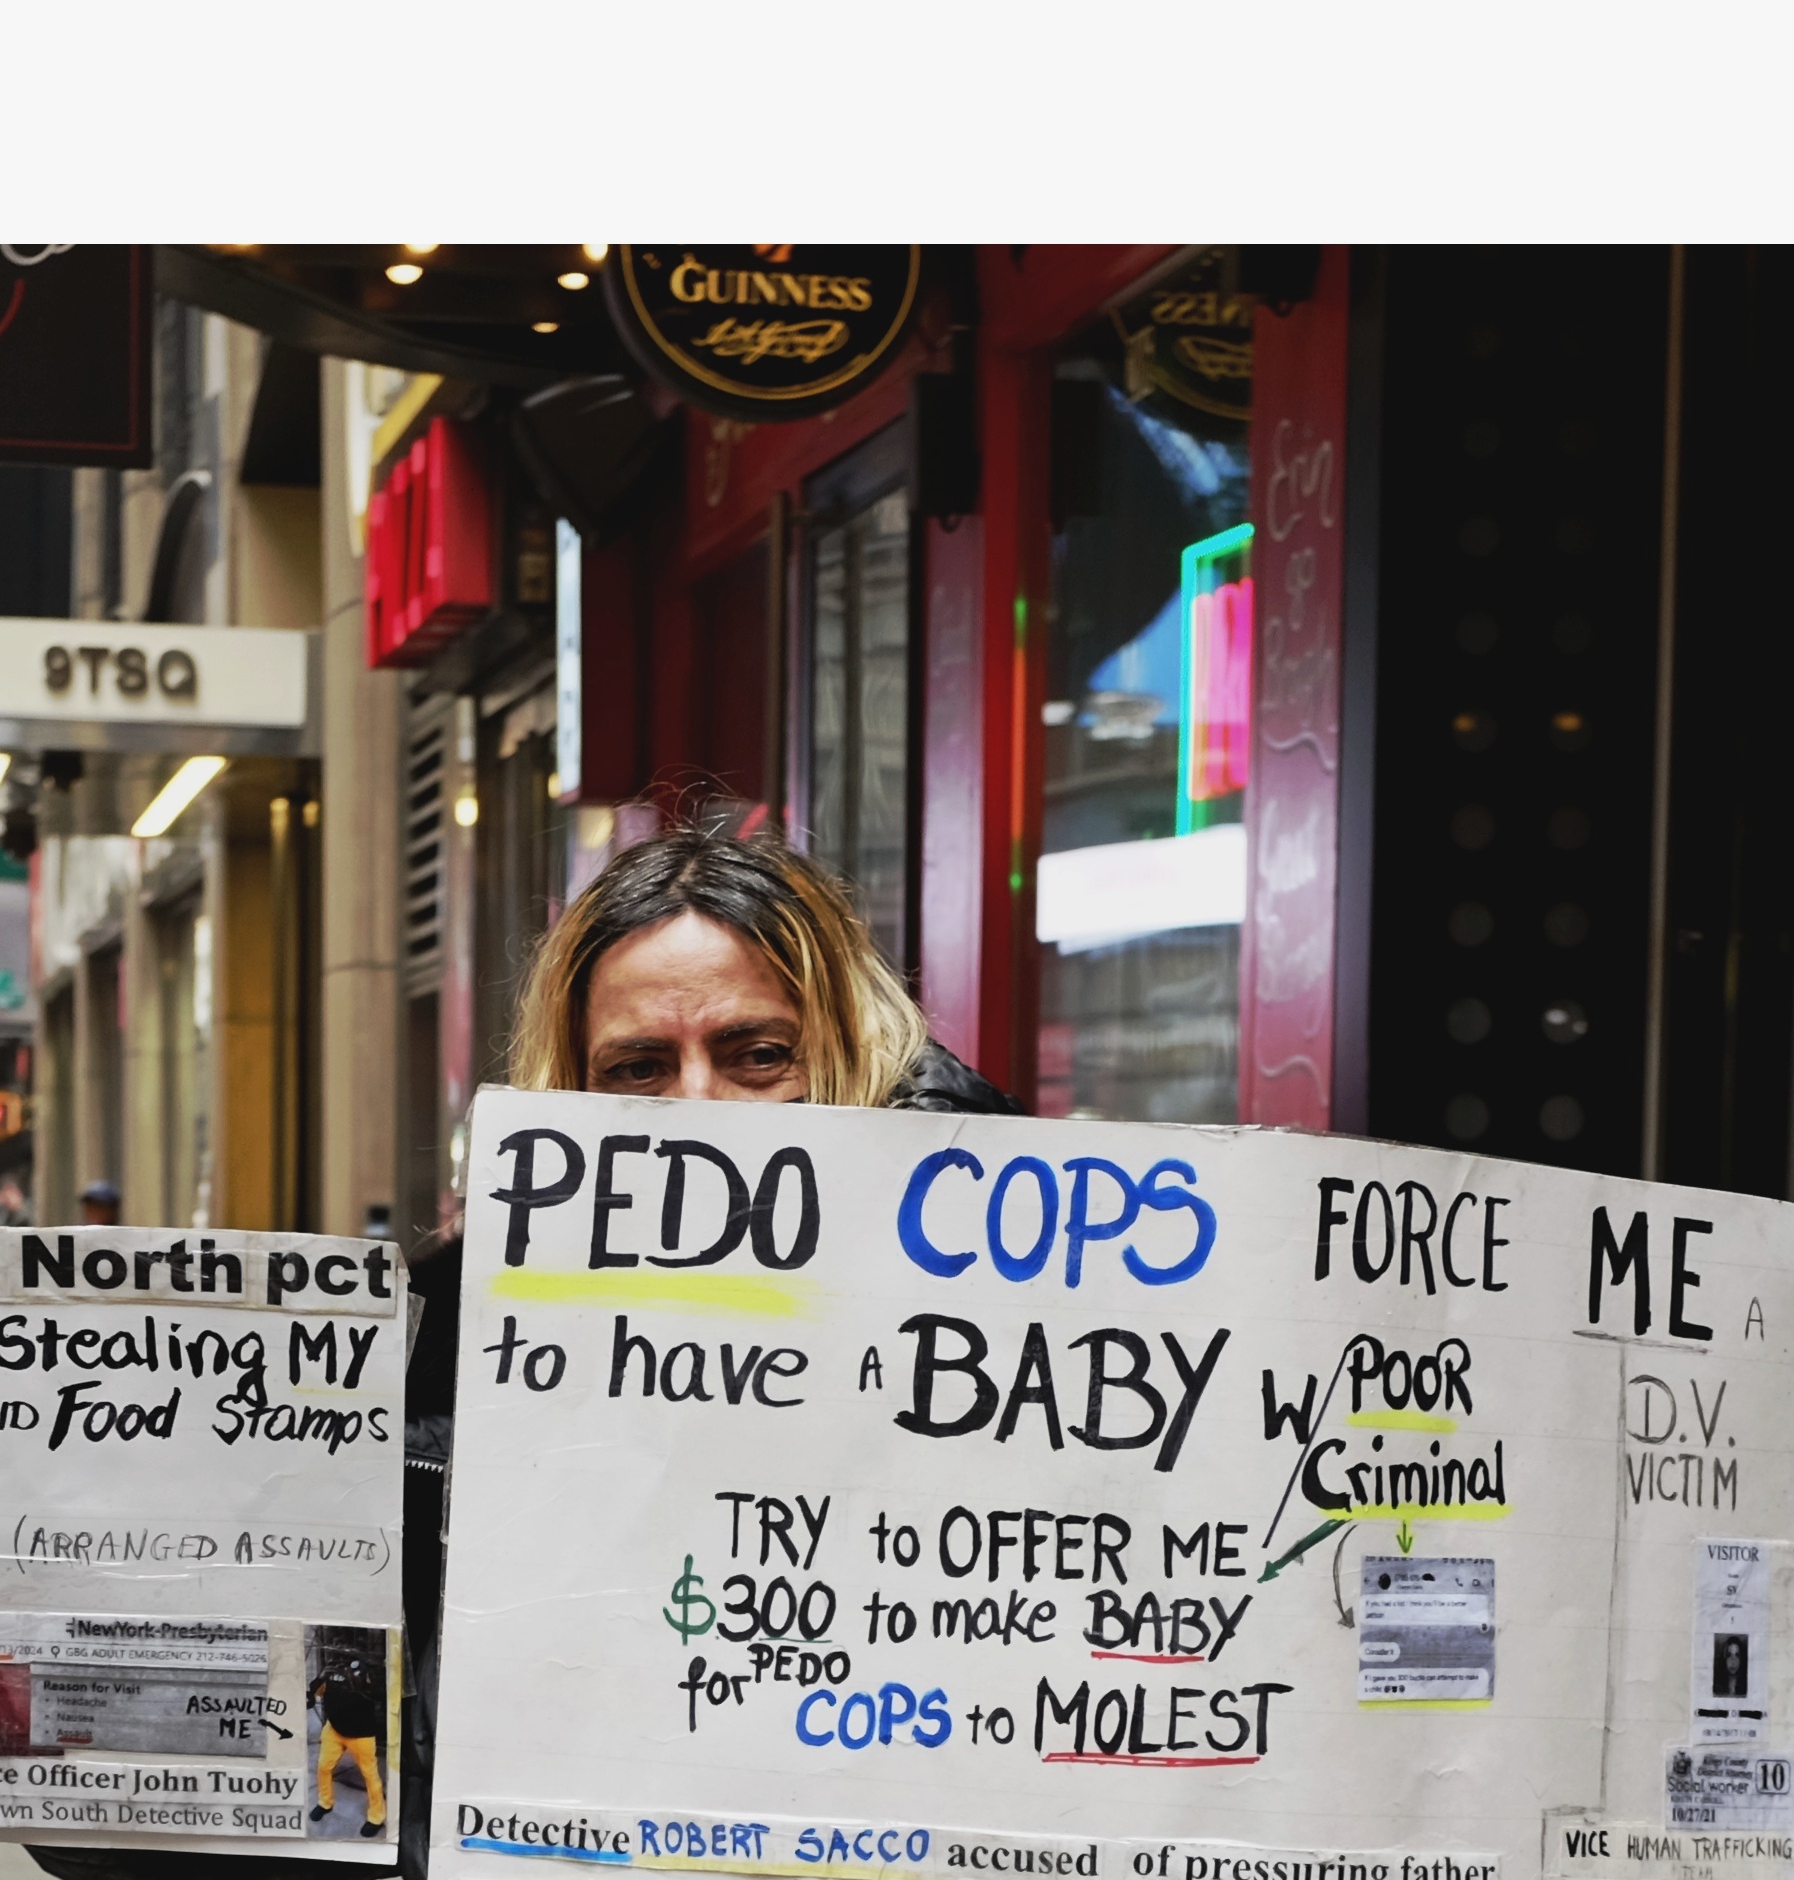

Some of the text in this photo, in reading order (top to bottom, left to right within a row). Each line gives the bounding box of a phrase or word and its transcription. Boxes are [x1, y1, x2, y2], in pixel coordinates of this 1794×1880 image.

[670, 260, 872, 312] GUINNESS
[42, 644, 199, 698] 9TSQ
[489, 1128, 1764, 1342] PEDO COPS FORCE ME A
[22, 1234, 242, 1293] North
[267, 1245, 392, 1306] pct
[289, 1320, 379, 1389] MY
[48, 1380, 181, 1451] Food
[212, 1393, 389, 1455] Stamps
[483, 1313, 1473, 1472] to have A BABY POOR
[1626, 1375, 1736, 1446] D.V.
[1301, 1435, 1506, 1513] Criminal
[1626, 1454, 1738, 1511] VICTIM
[13, 1514, 218, 1574] (ARRANGED
[715, 1492, 1247, 1584] TRY to OFFER ME
[1707, 1544, 1760, 1564] VISITOR
[78, 1619, 269, 1644] NewYork-Presbyterian
[662, 1554, 1254, 1662] $300 to make BABY
[92, 1648, 192, 1662] ADULT EMERGENCY
[43, 1681, 141, 1695] Reason for Visit
[186, 1695, 287, 1717] ASSAULTED
[679, 1644, 851, 1733] for PEDO
[795, 1676, 1293, 1755] COPS to MOLEST
[57, 1713, 95, 1723] Nausea
[219, 1719, 252, 1739] ME
[27, 1764, 125, 1789] Officer
[133, 1769, 199, 1794] John
[208, 1771, 298, 1799] Tuohy
[1668, 1777, 1749, 1794] Social worker
[1761, 1763, 1785, 1791] 10
[42, 1802, 107, 1824] South
[118, 1804, 223, 1826] Detective
[232, 1809, 302, 1833] Squad
[457, 1804, 630, 1855] Detective
[638, 1818, 771, 1860] ROBERT
[794, 1827, 931, 1864] SACCO
[947, 1843, 1098, 1877] accused
[1132, 1845, 1176, 1877] of
[1566, 1830, 1793, 1861] VICE HUMAN TRAFFICKING
